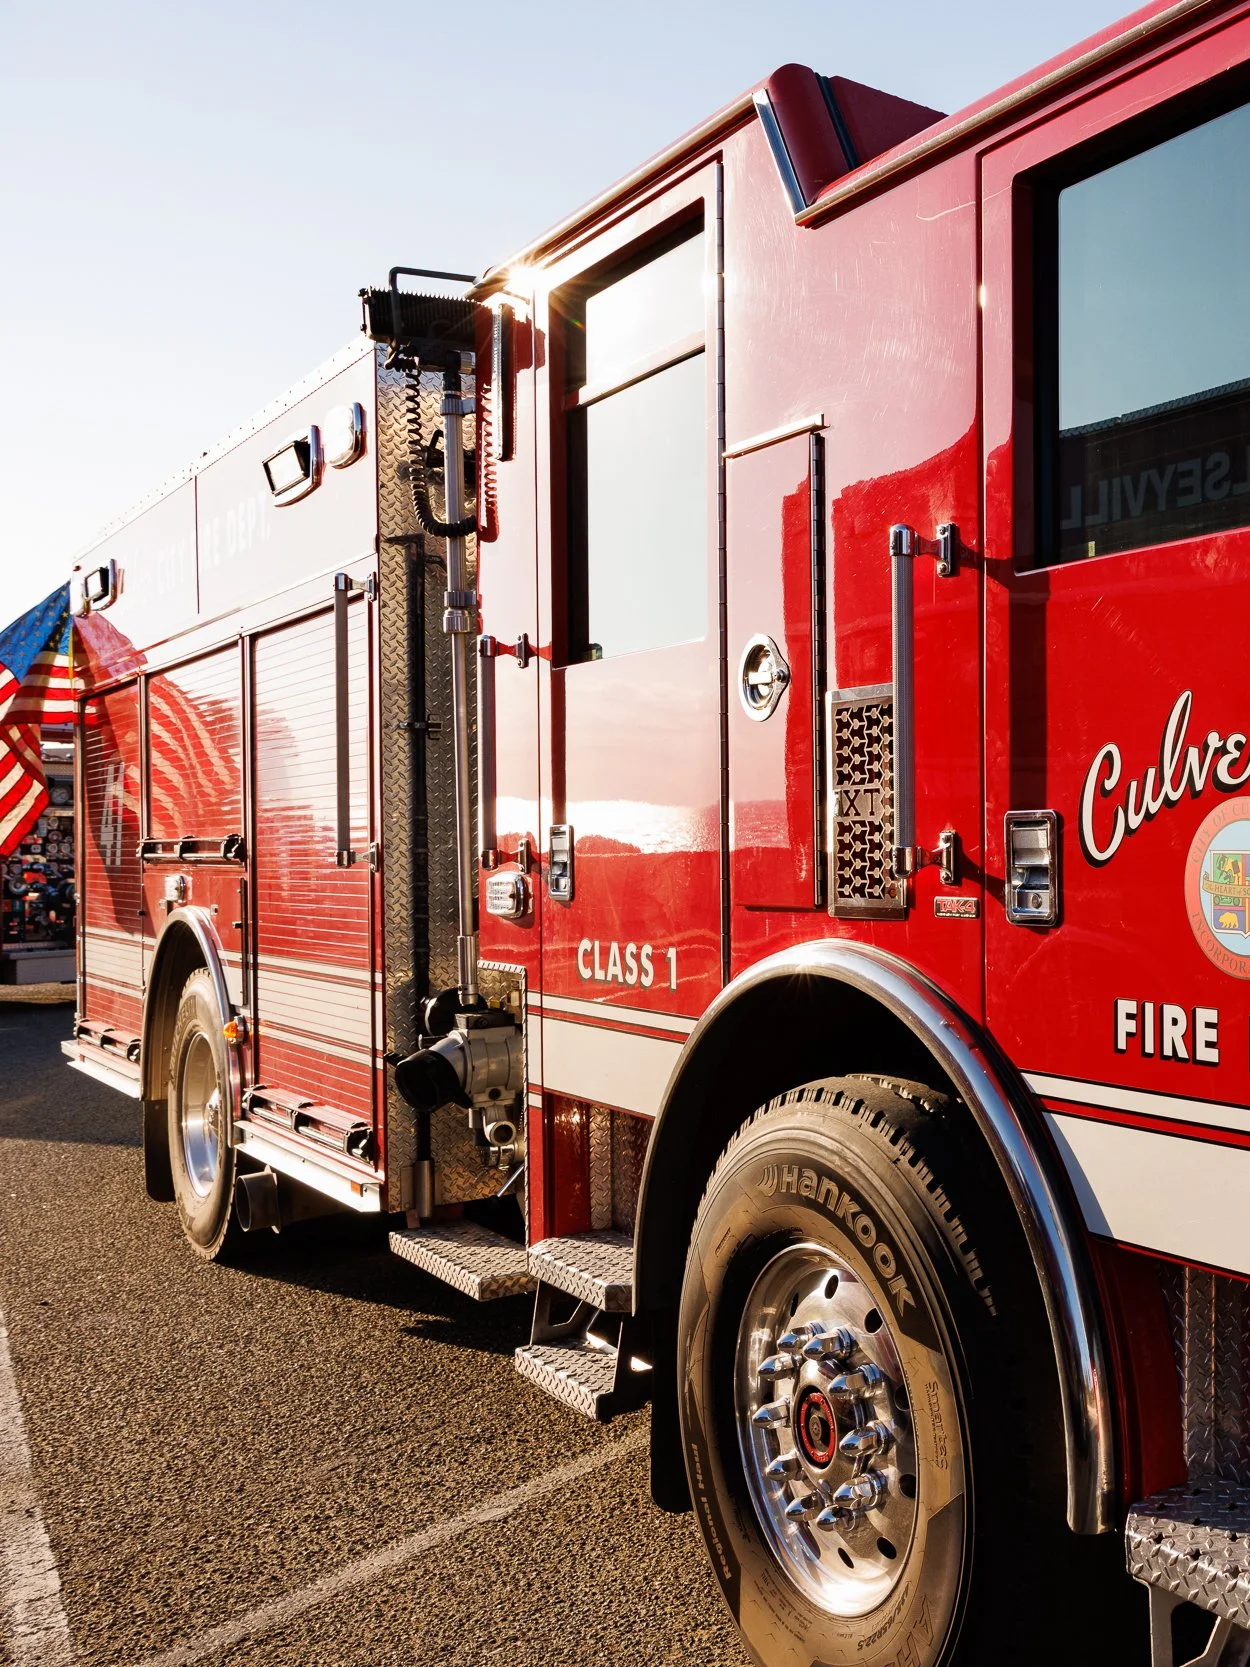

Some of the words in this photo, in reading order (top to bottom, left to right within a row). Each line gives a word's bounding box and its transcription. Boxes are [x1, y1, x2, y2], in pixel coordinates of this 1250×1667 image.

[100, 761, 126, 868] 41
[843, 788, 881, 817] XT
[1192, 827, 1212, 864] CITY
[1212, 809, 1227, 827] OF
[937, 899, 976, 913] TAK-4
[1215, 885, 1237, 896] HEART
[577, 938, 654, 989] CLASS
[666, 946, 677, 992] 1
[1114, 998, 1220, 1063] FIRE
[691, 1443, 705, 1491] Haul
[701, 1496, 732, 1581] Regional
